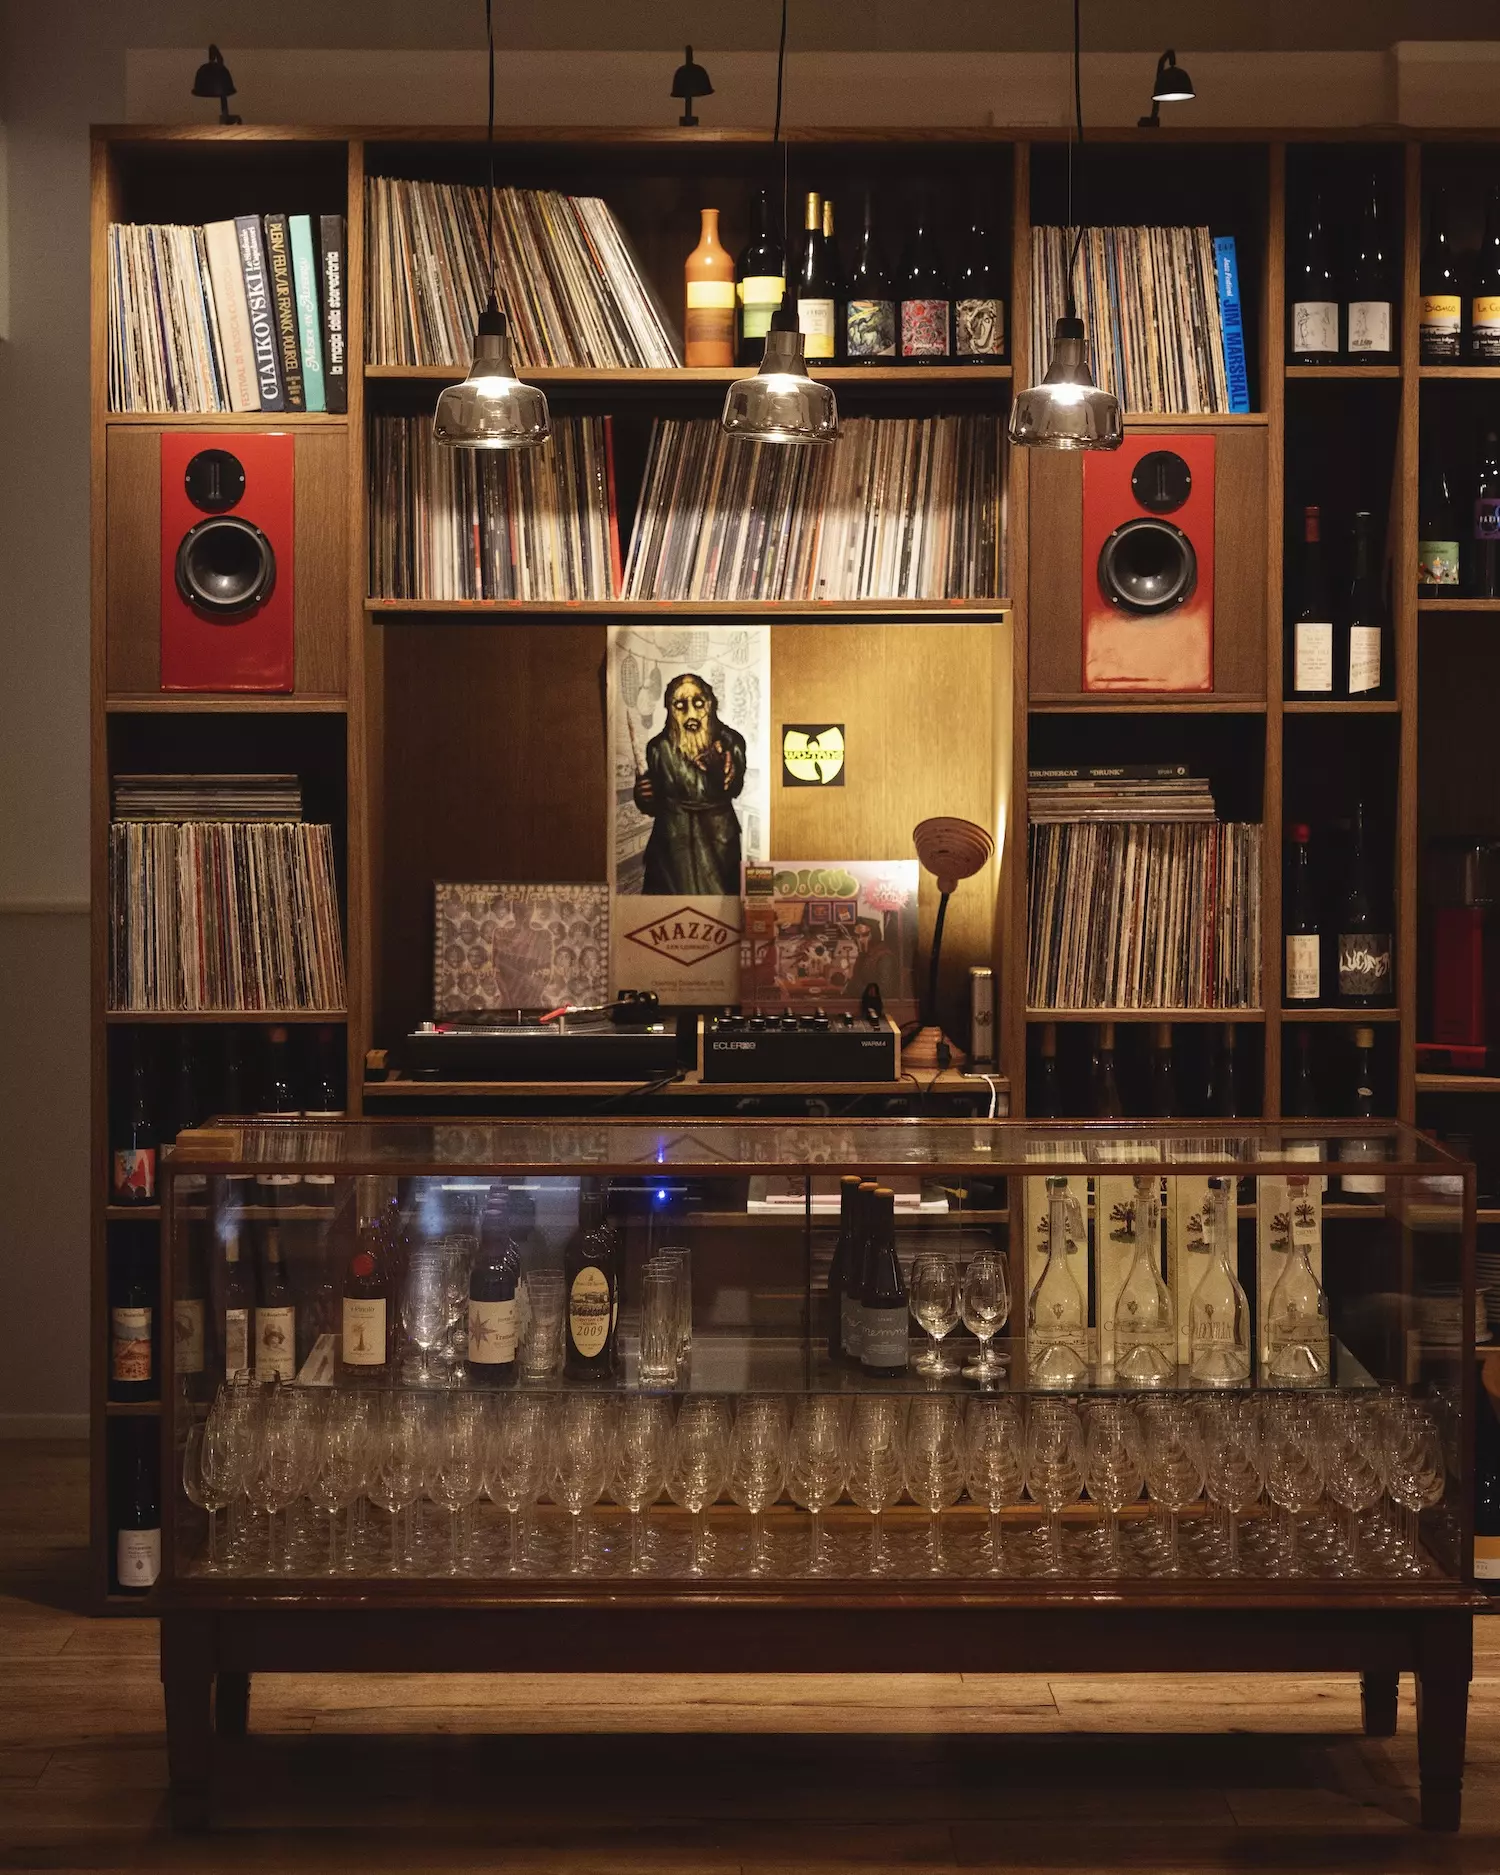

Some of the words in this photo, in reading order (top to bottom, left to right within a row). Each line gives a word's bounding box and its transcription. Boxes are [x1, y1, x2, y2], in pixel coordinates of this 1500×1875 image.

[325, 252, 341, 308] stereofonia
[327, 310, 341, 331] della
[1223, 299, 1241, 327] JIM
[246, 272, 279, 400] CIAIKOVSKI
[328, 334, 344, 363] magia
[329, 366, 343, 375] la
[1226, 332, 1248, 409] MARSHALL
[236, 367, 250, 407] FESTIVAL
[1028, 769, 1079, 778] THUNDERCAT
[649, 922, 728, 946] MAZZO
[1339, 948, 1390, 978] LUCIFER
[576, 1325, 603, 1337] 2009
